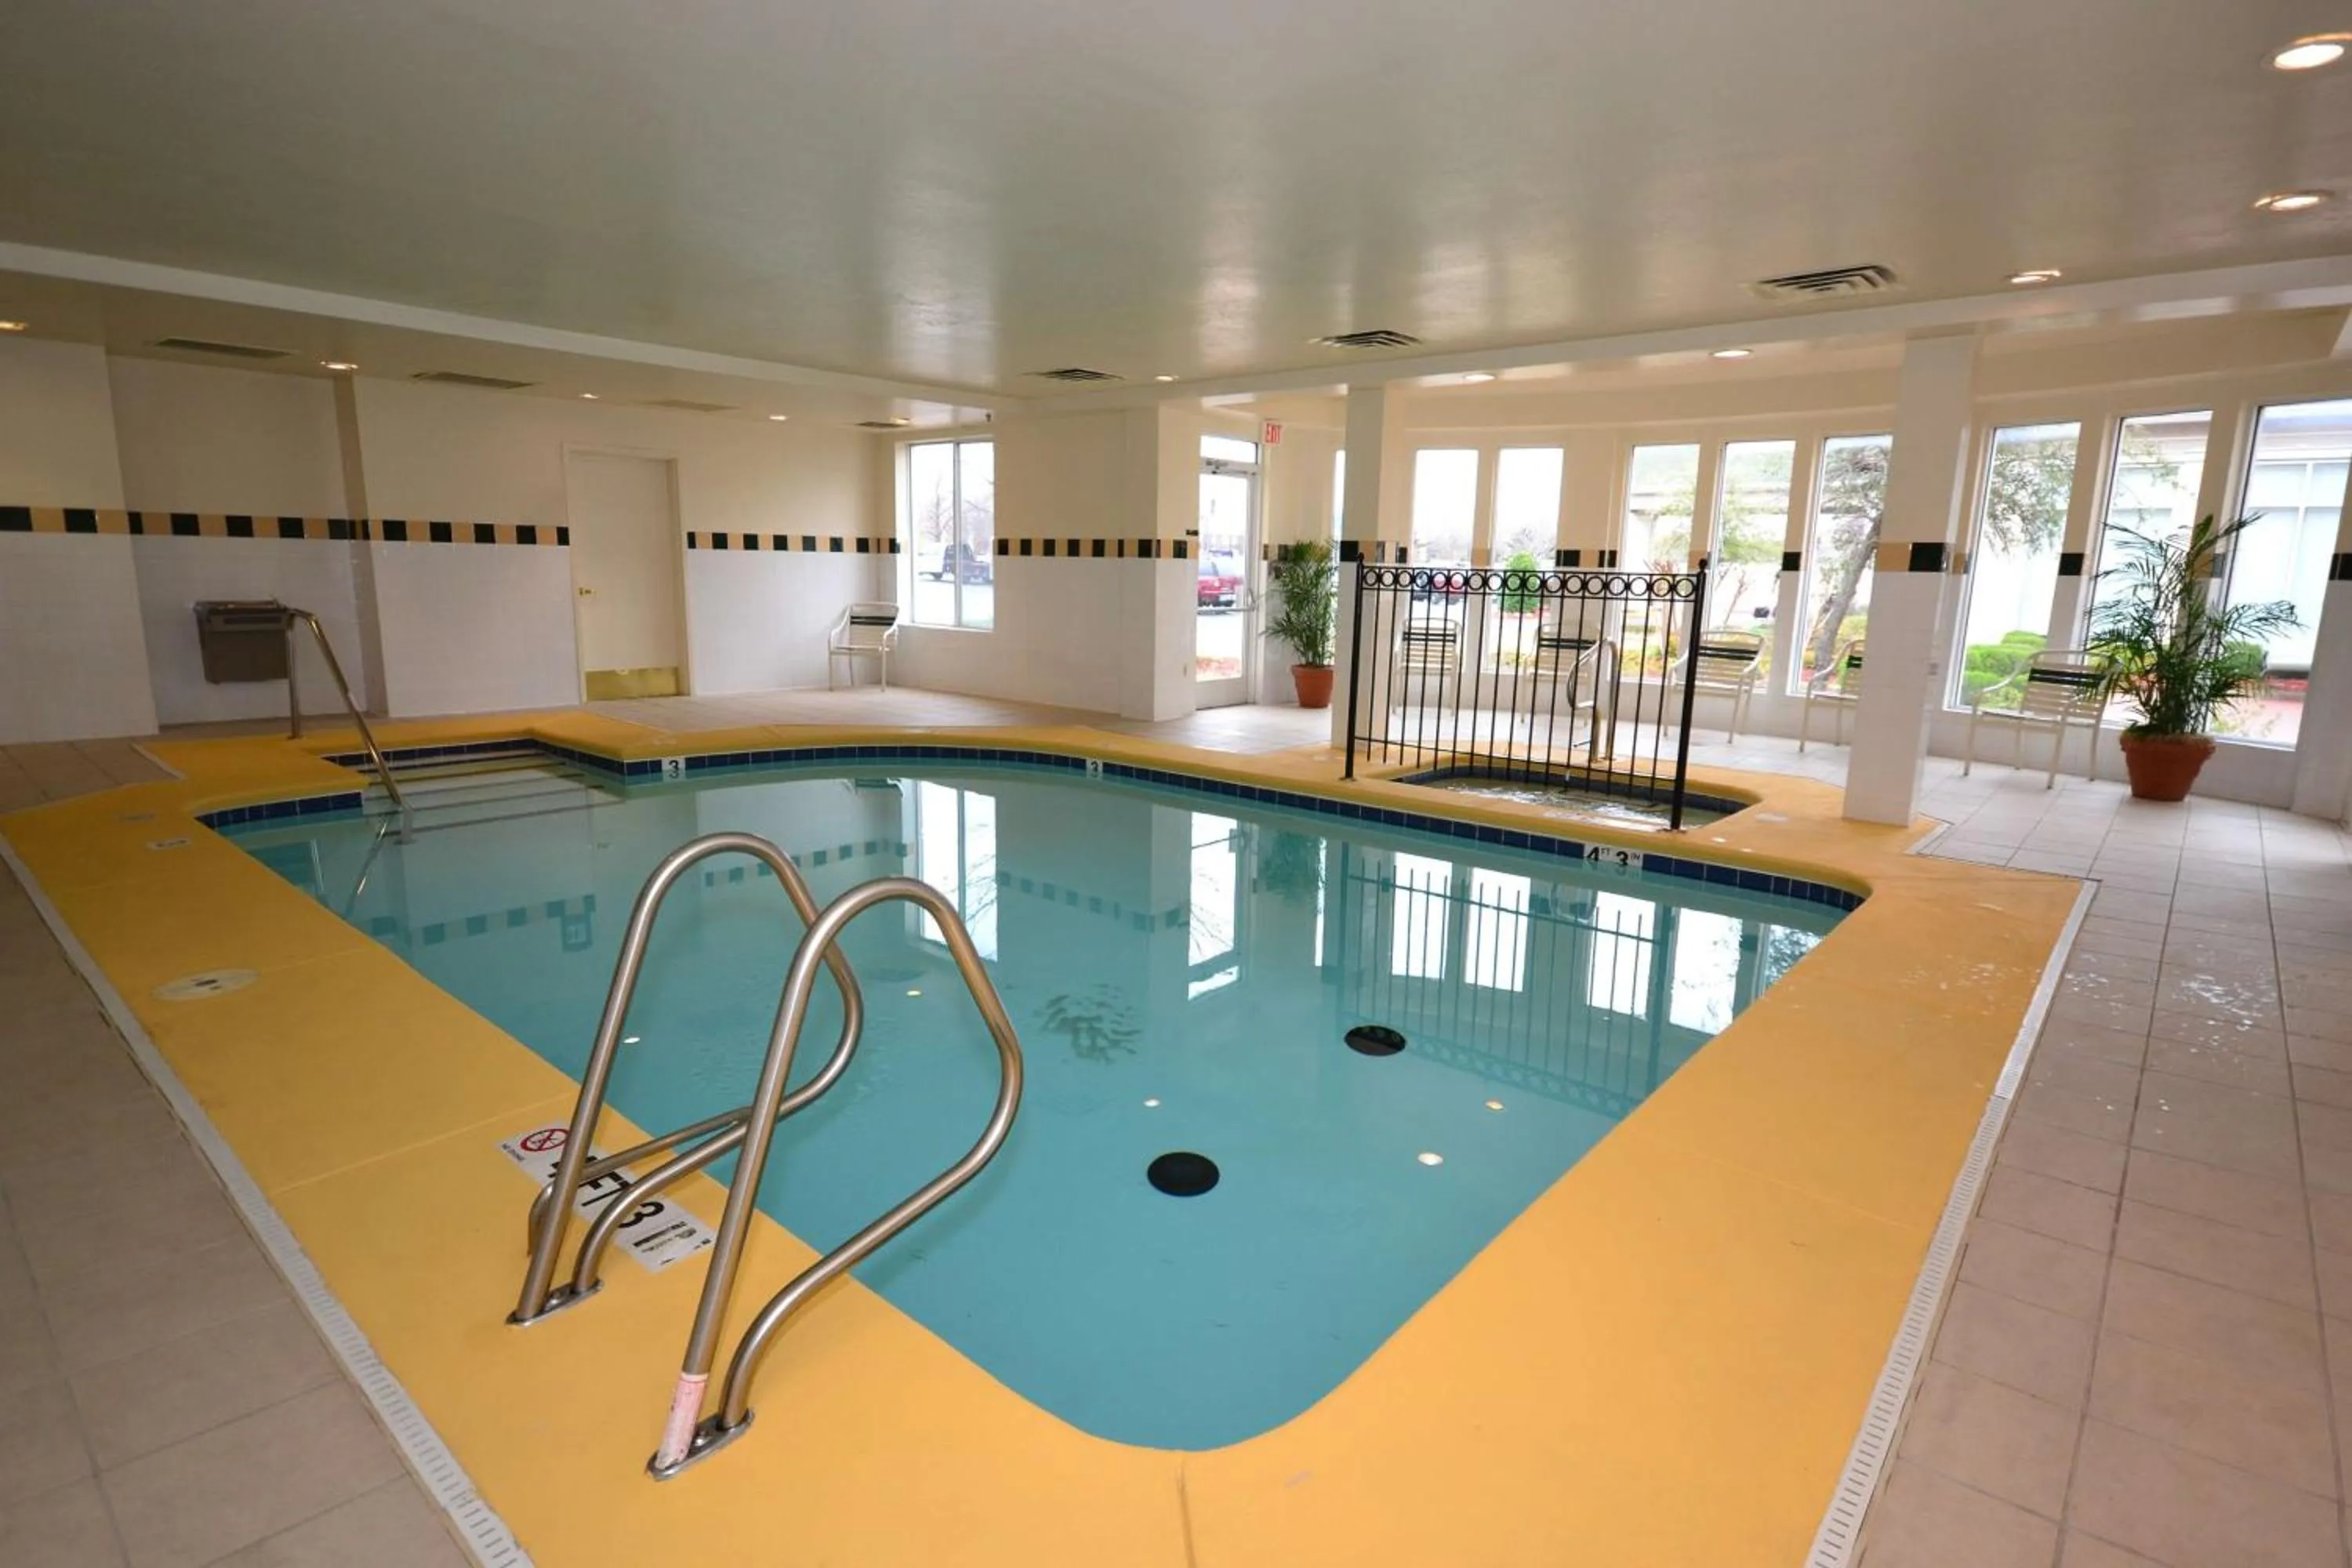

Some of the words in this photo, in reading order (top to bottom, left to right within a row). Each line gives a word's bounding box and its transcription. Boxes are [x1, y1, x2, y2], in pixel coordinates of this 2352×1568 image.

[1265, 423, 1283, 444] EXIT
[668, 760, 680, 777] 3
[1586, 846, 1600, 862] 4
[1616, 851, 1628, 866] 3
